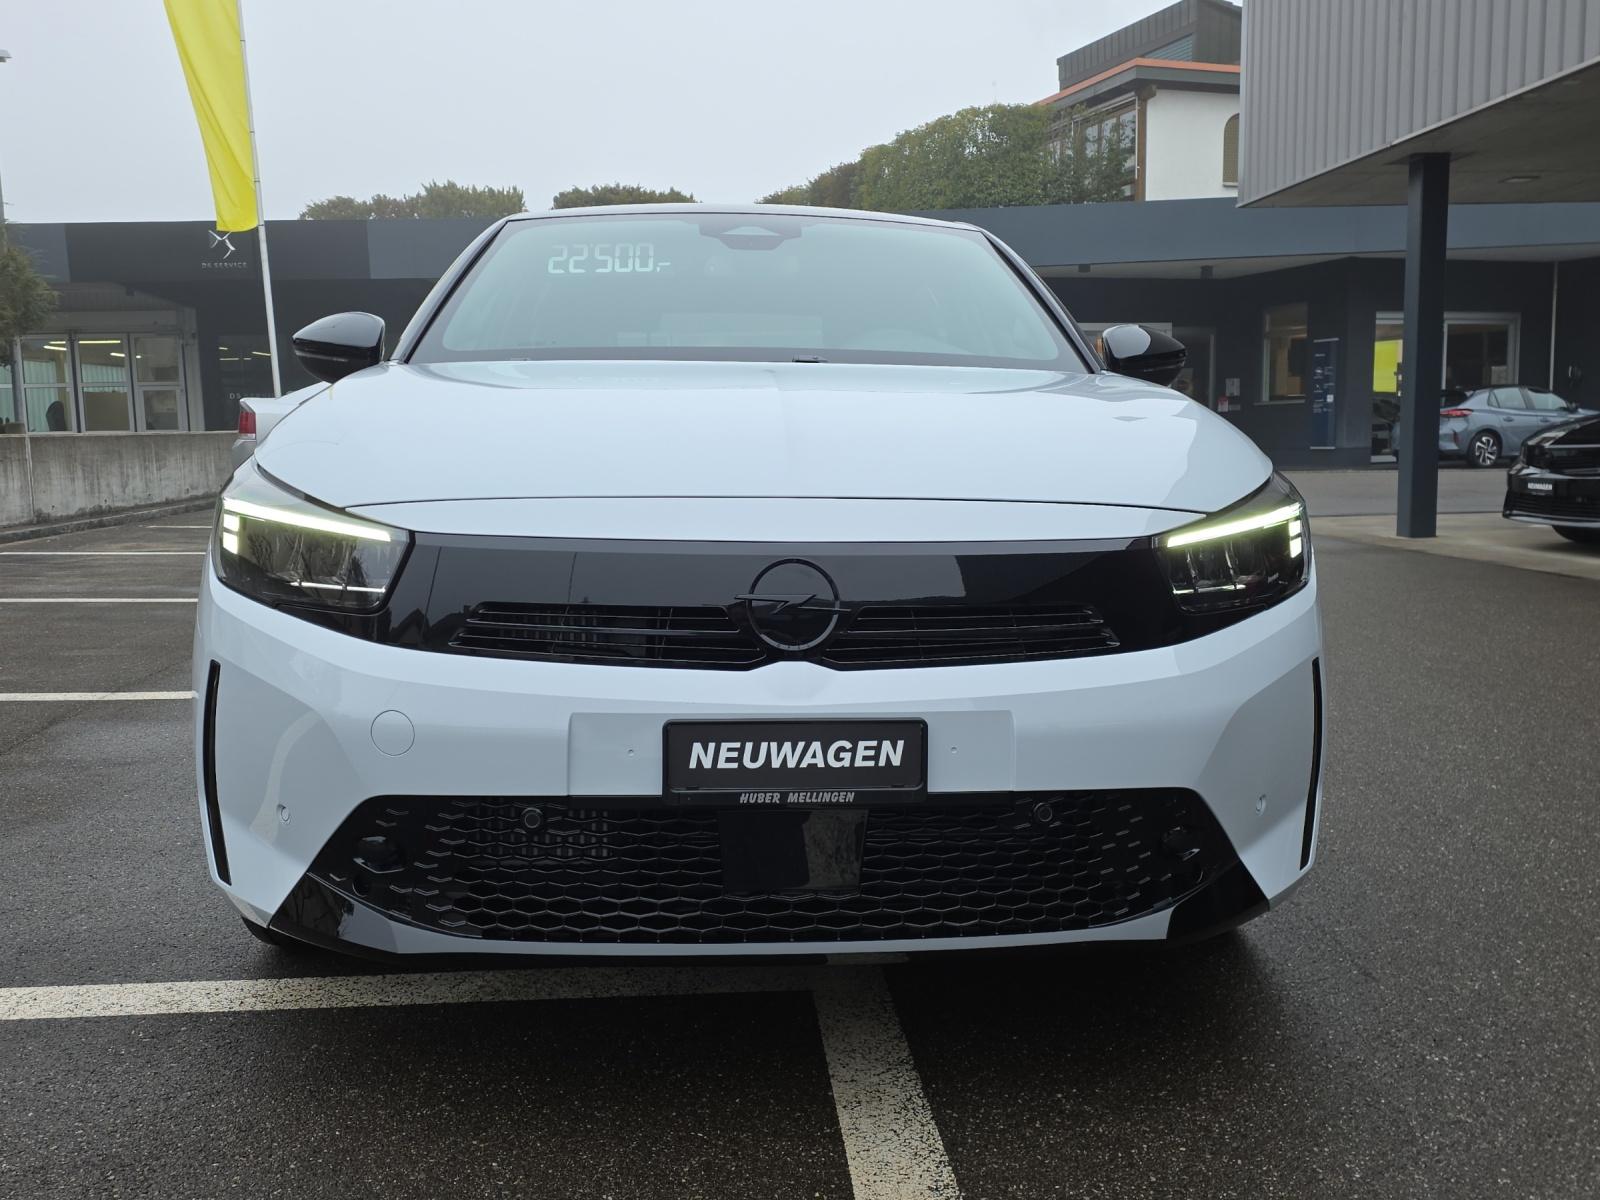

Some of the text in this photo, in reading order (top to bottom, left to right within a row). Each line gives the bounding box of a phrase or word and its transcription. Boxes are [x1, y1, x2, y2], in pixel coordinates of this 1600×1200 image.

[689, 740, 904, 769] NEUWAGEN
[739, 791, 855, 804] HUBER MELLINGEN
